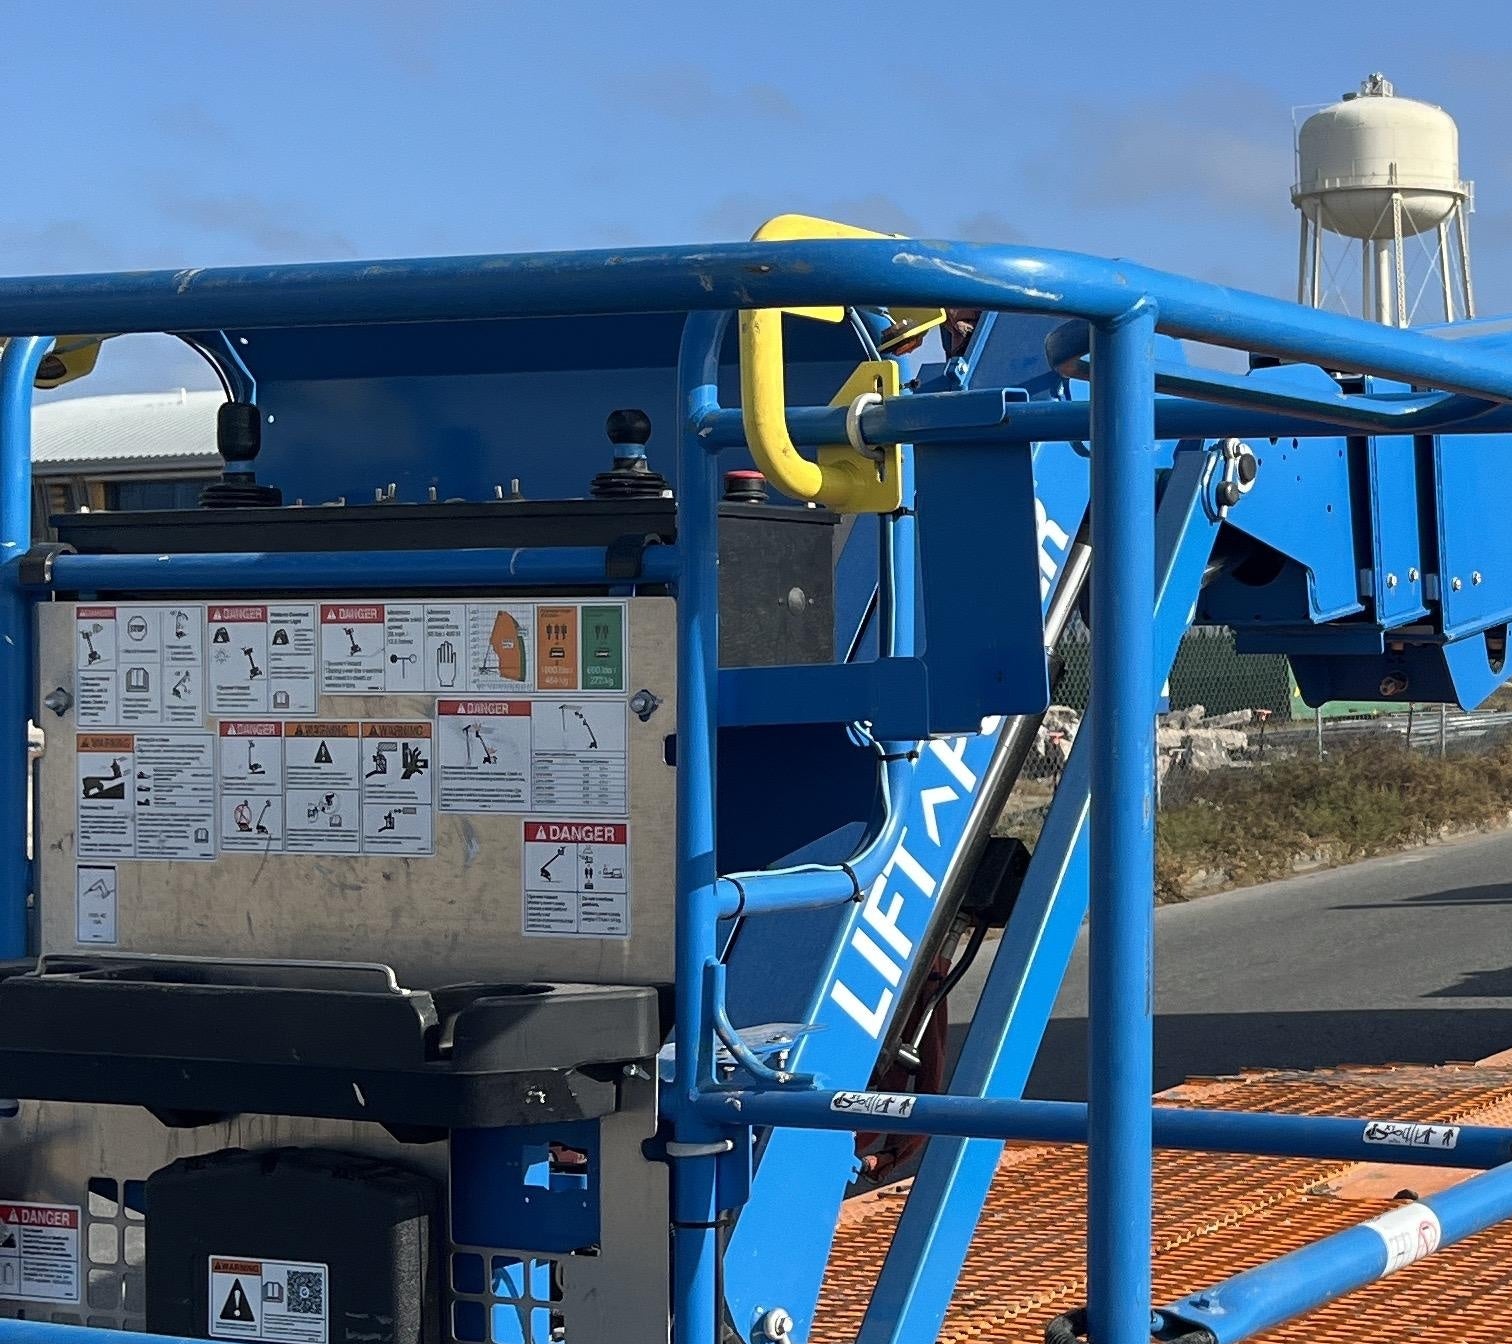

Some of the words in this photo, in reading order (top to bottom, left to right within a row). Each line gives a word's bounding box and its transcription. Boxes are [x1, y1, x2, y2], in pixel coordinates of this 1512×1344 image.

[223, 607, 262, 620] DANGER
[338, 608, 378, 620] DANGER
[467, 703, 510, 714] DANGER
[236, 724, 275, 736] DANGER
[378, 725, 424, 736] WARNING
[549, 825, 615, 842] DANGER
[831, 827, 937, 1039] LIFT
[21, 1209, 70, 1226] DANGER
[221, 1262, 259, 1273] WARNING
